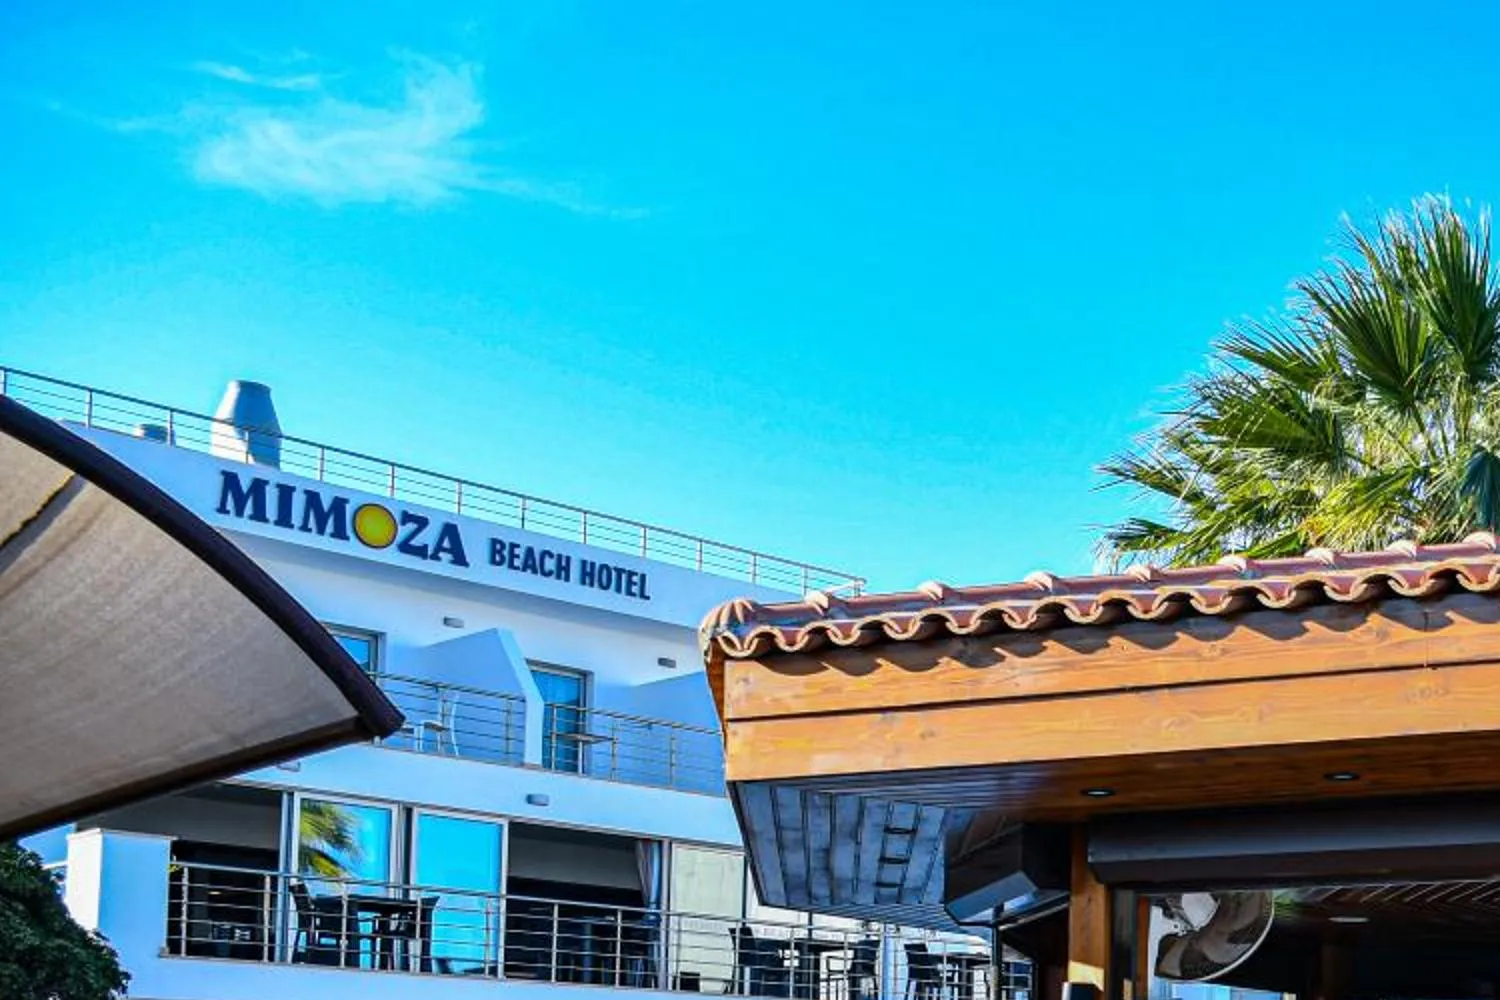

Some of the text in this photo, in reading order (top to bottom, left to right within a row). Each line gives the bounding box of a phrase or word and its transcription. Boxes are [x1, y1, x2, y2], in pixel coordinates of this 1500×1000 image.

[216, 470, 650, 600] MIMOZA BEACH HOTEL
